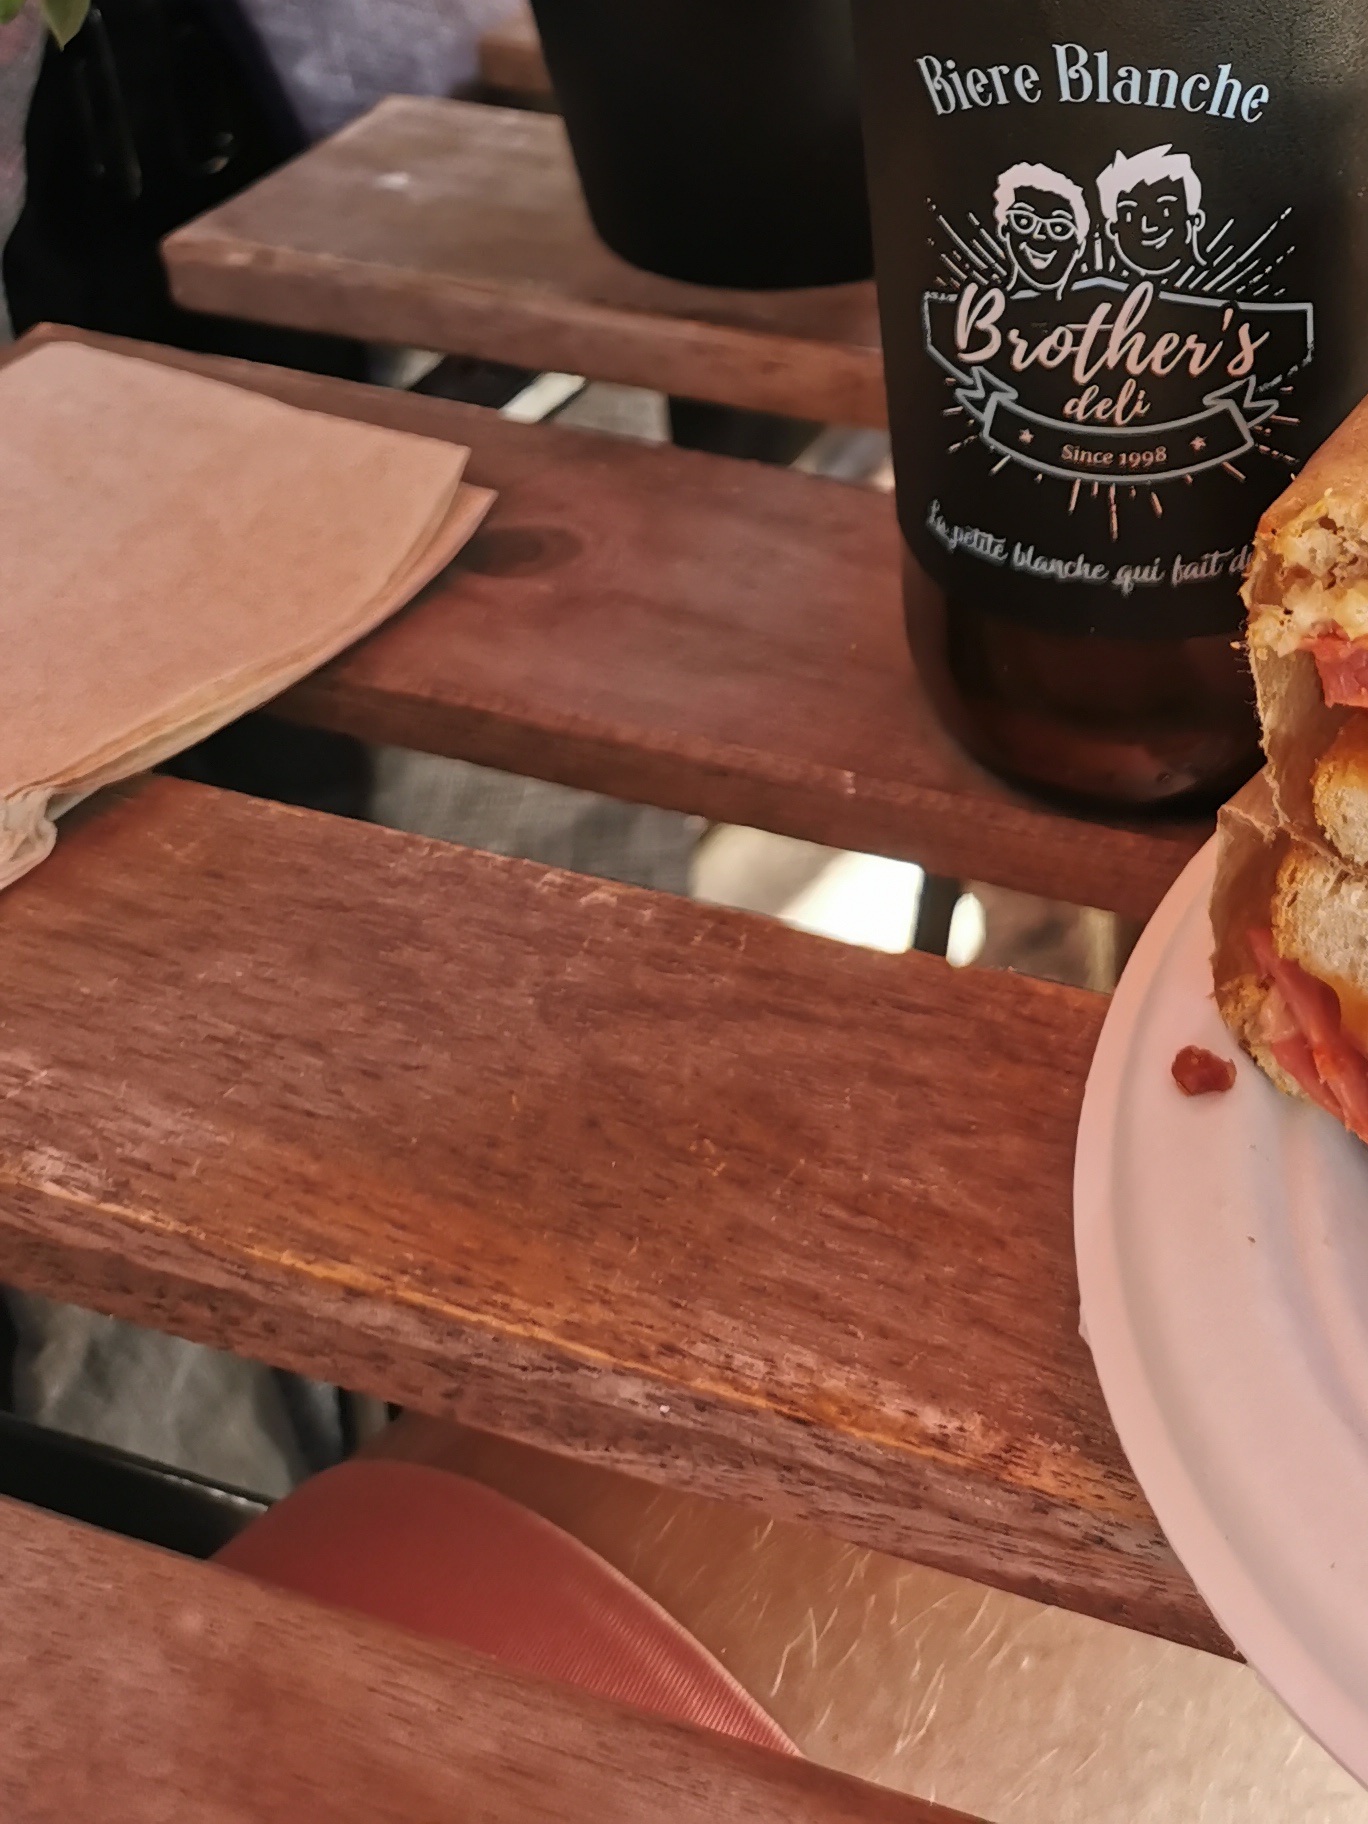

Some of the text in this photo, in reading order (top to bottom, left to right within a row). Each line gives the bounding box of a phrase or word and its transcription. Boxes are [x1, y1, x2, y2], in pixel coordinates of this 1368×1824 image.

[915, 43, 1270, 123] Biere Blanche
[954, 281, 1270, 385] Brother's
[1063, 378, 1151, 426] deli
[1061, 444, 1168, 467] Since 1998
[948, 526, 1009, 561] petite
[1011, 542, 1109, 580] blanche
[1112, 557, 1165, 596] qui
[1172, 549, 1235, 586] fait
